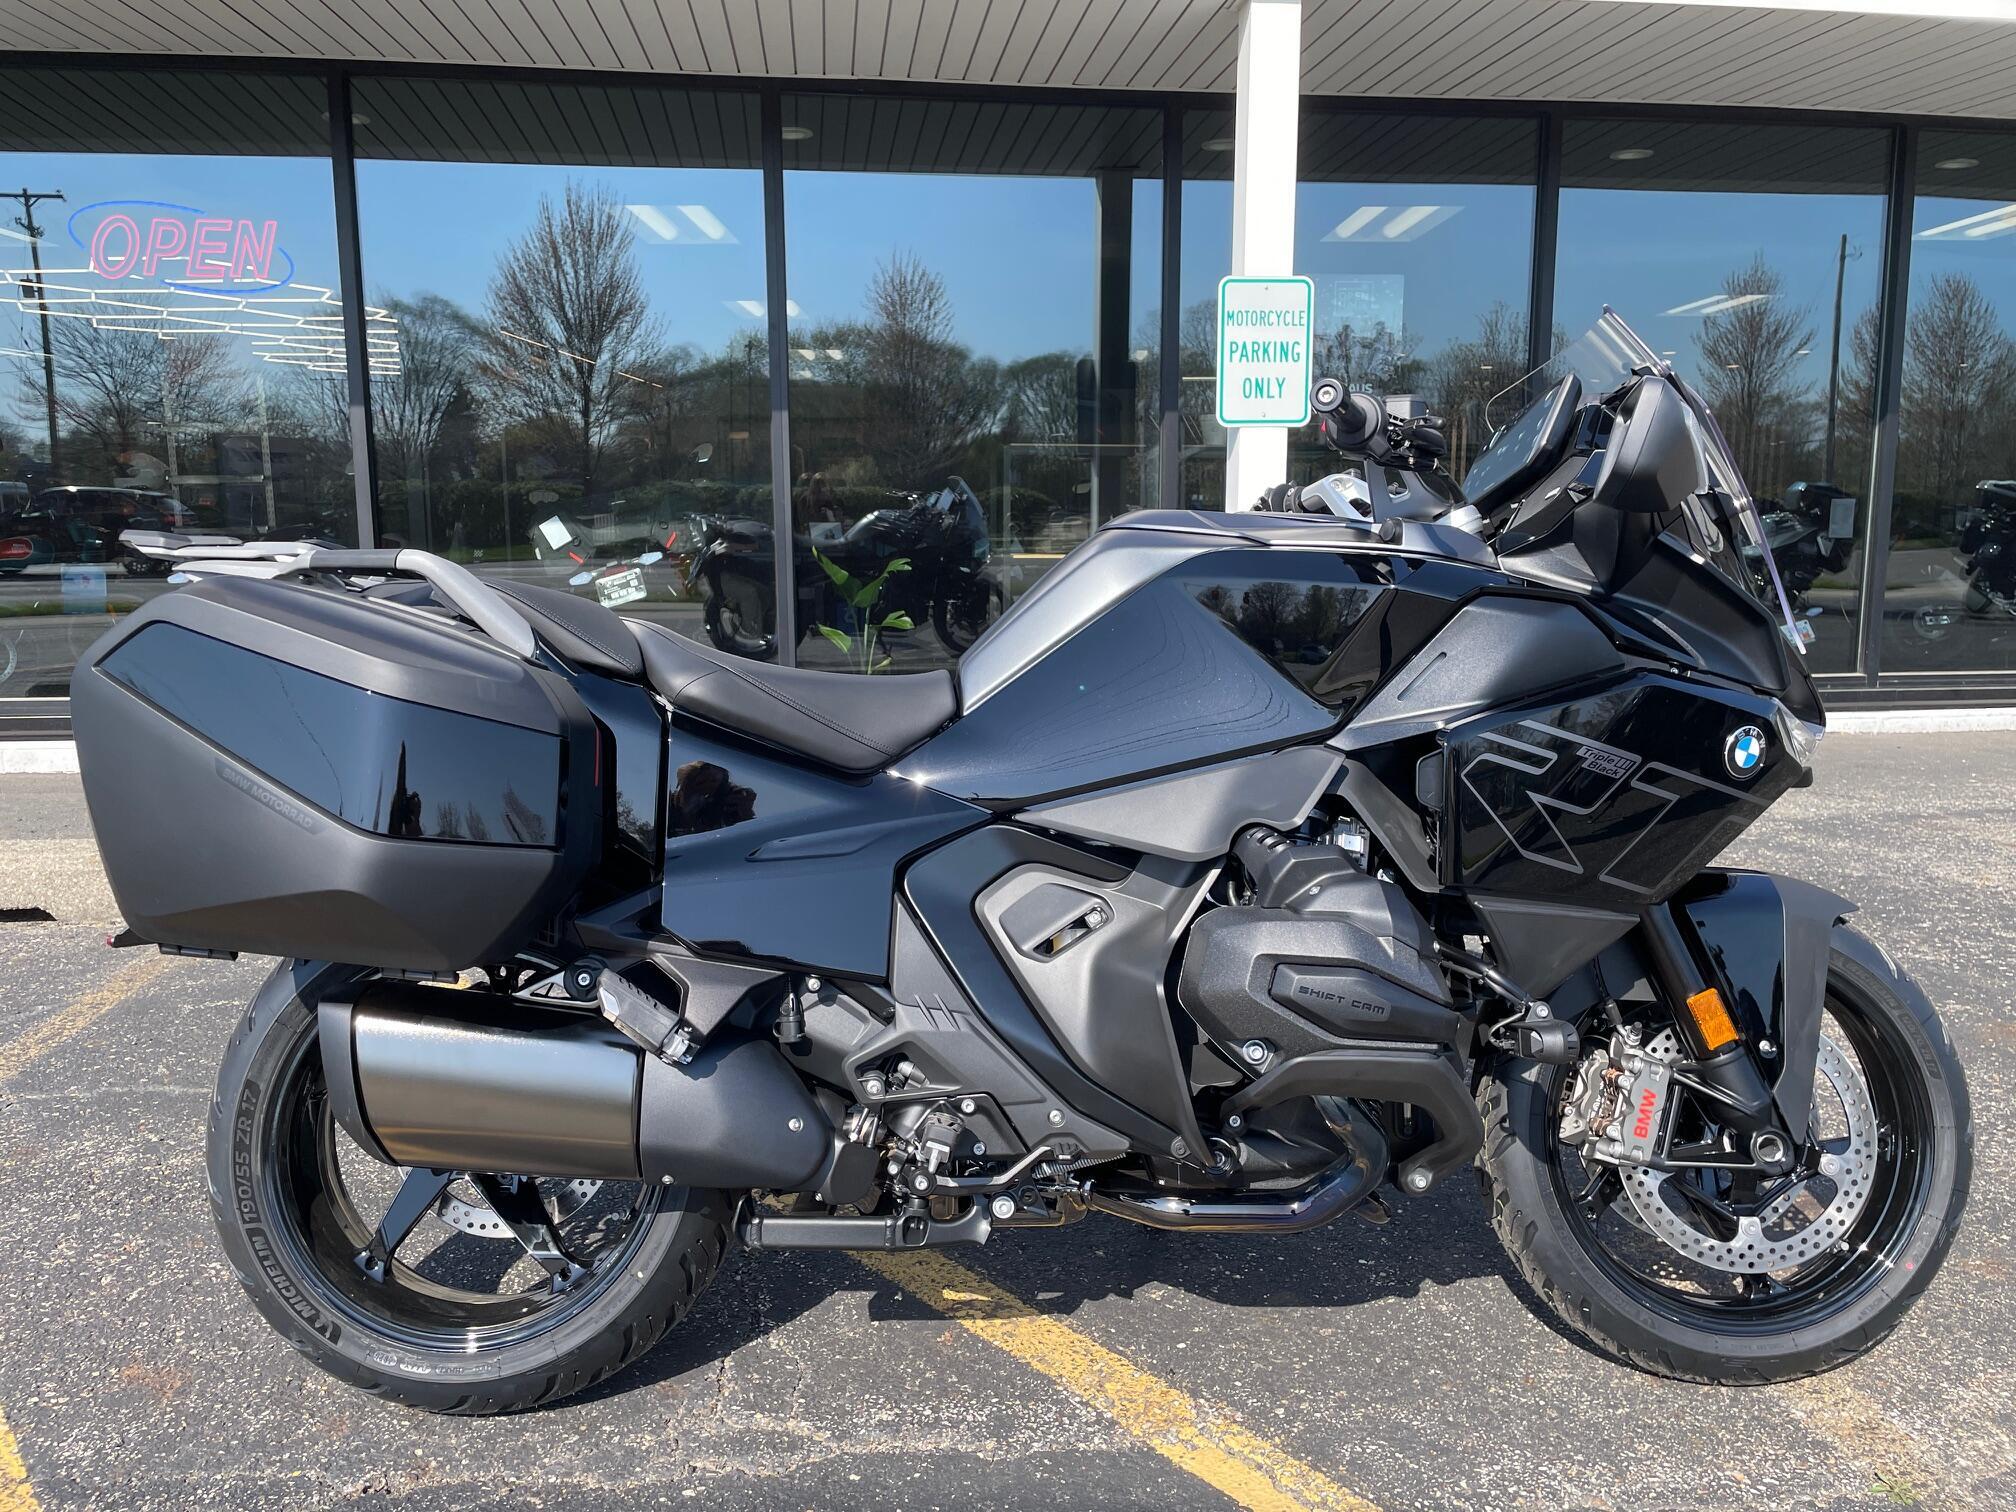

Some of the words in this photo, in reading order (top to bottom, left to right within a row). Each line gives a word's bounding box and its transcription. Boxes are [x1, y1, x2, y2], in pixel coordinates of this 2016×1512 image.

[91, 214, 278, 280] OPEN
[1226, 310, 1305, 327] MOTORCYCLE
[1229, 341, 1301, 363] PARKING
[1243, 377, 1286, 399] ONLY
[1583, 747, 1615, 764] Triple
[1587, 761, 1619, 776] Black
[222, 768, 251, 790] BMW
[251, 785, 313, 828] MOTORRAD
[1298, 985, 1345, 1004] SHIFT
[1351, 1000, 1385, 1015] CAM
[242, 1088, 259, 1112] 17
[1634, 1088, 1657, 1138] BMW
[236, 1116, 252, 1145] ZR
[235, 1151, 258, 1224] 190/55
[252, 1236, 316, 1319] MICHELIN
